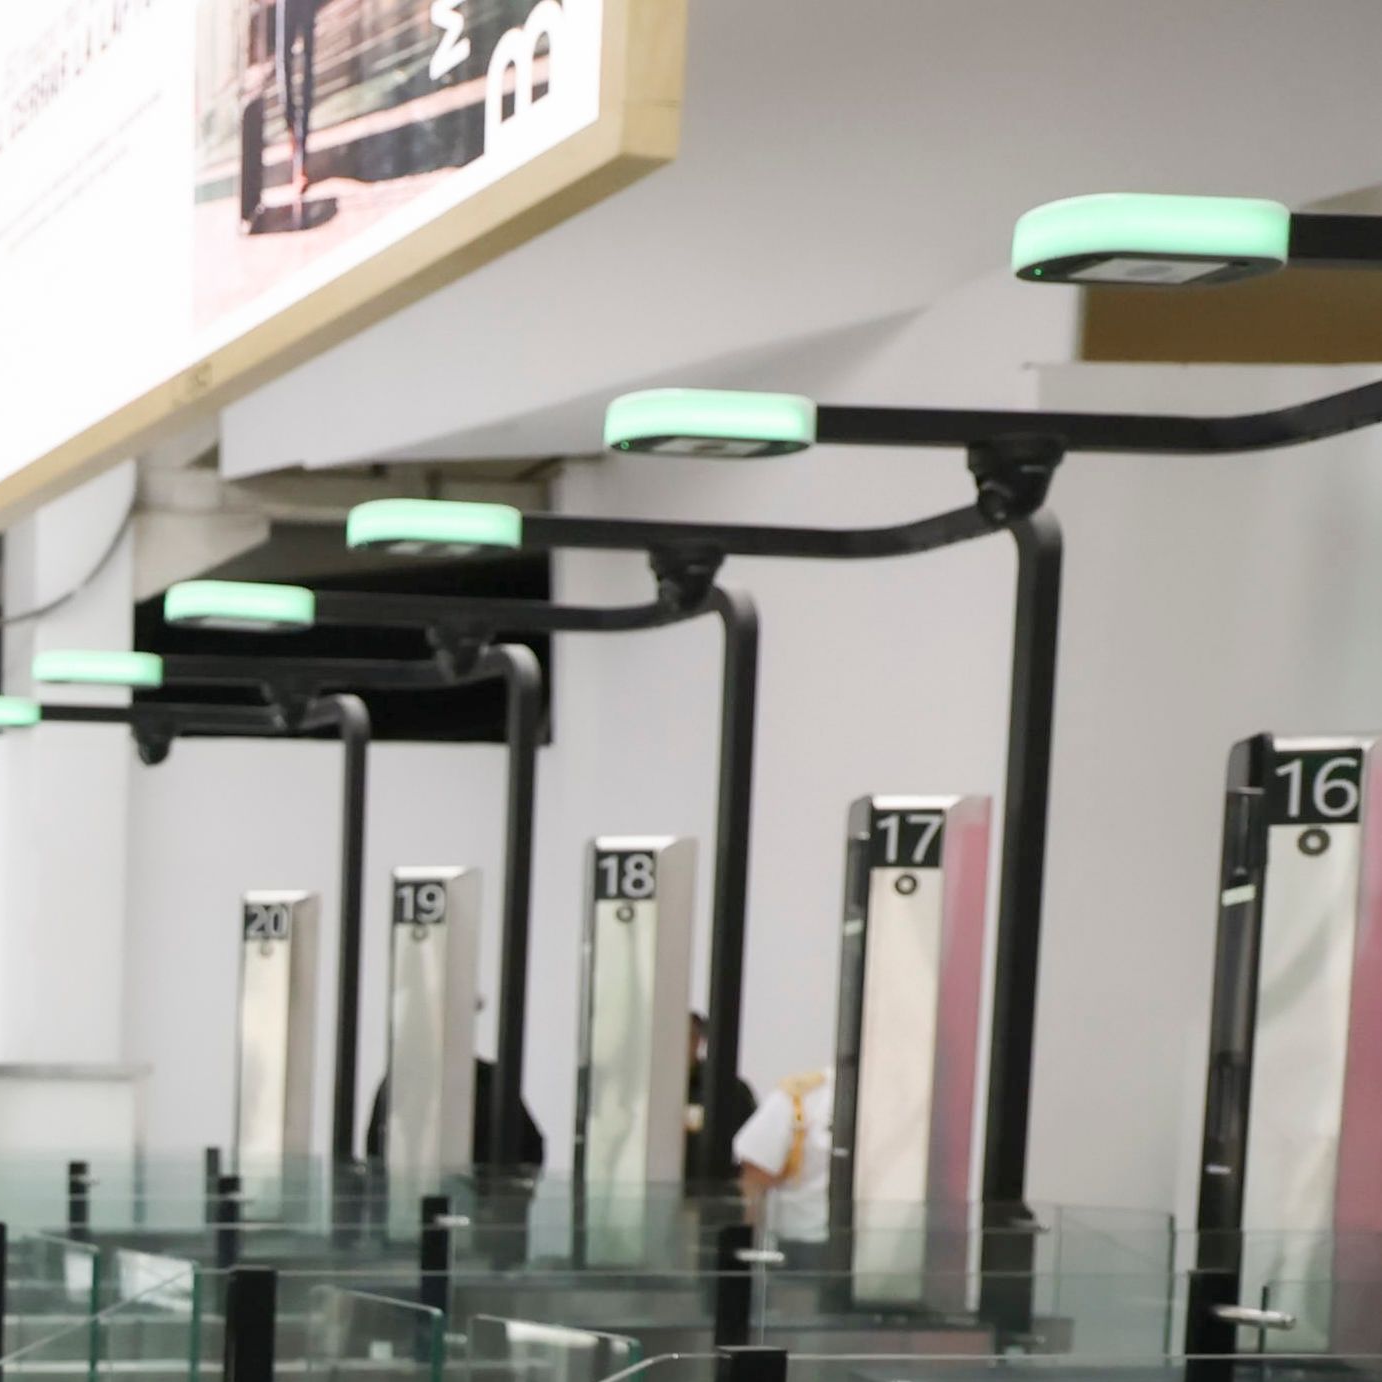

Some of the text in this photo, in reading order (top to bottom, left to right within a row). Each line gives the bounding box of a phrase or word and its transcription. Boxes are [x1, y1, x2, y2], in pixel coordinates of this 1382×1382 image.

[1275, 756, 1359, 818] 16
[876, 813, 944, 864] 17
[598, 853, 656, 898] 18
[246, 903, 288, 940] 20
[397, 883, 448, 923] 19
